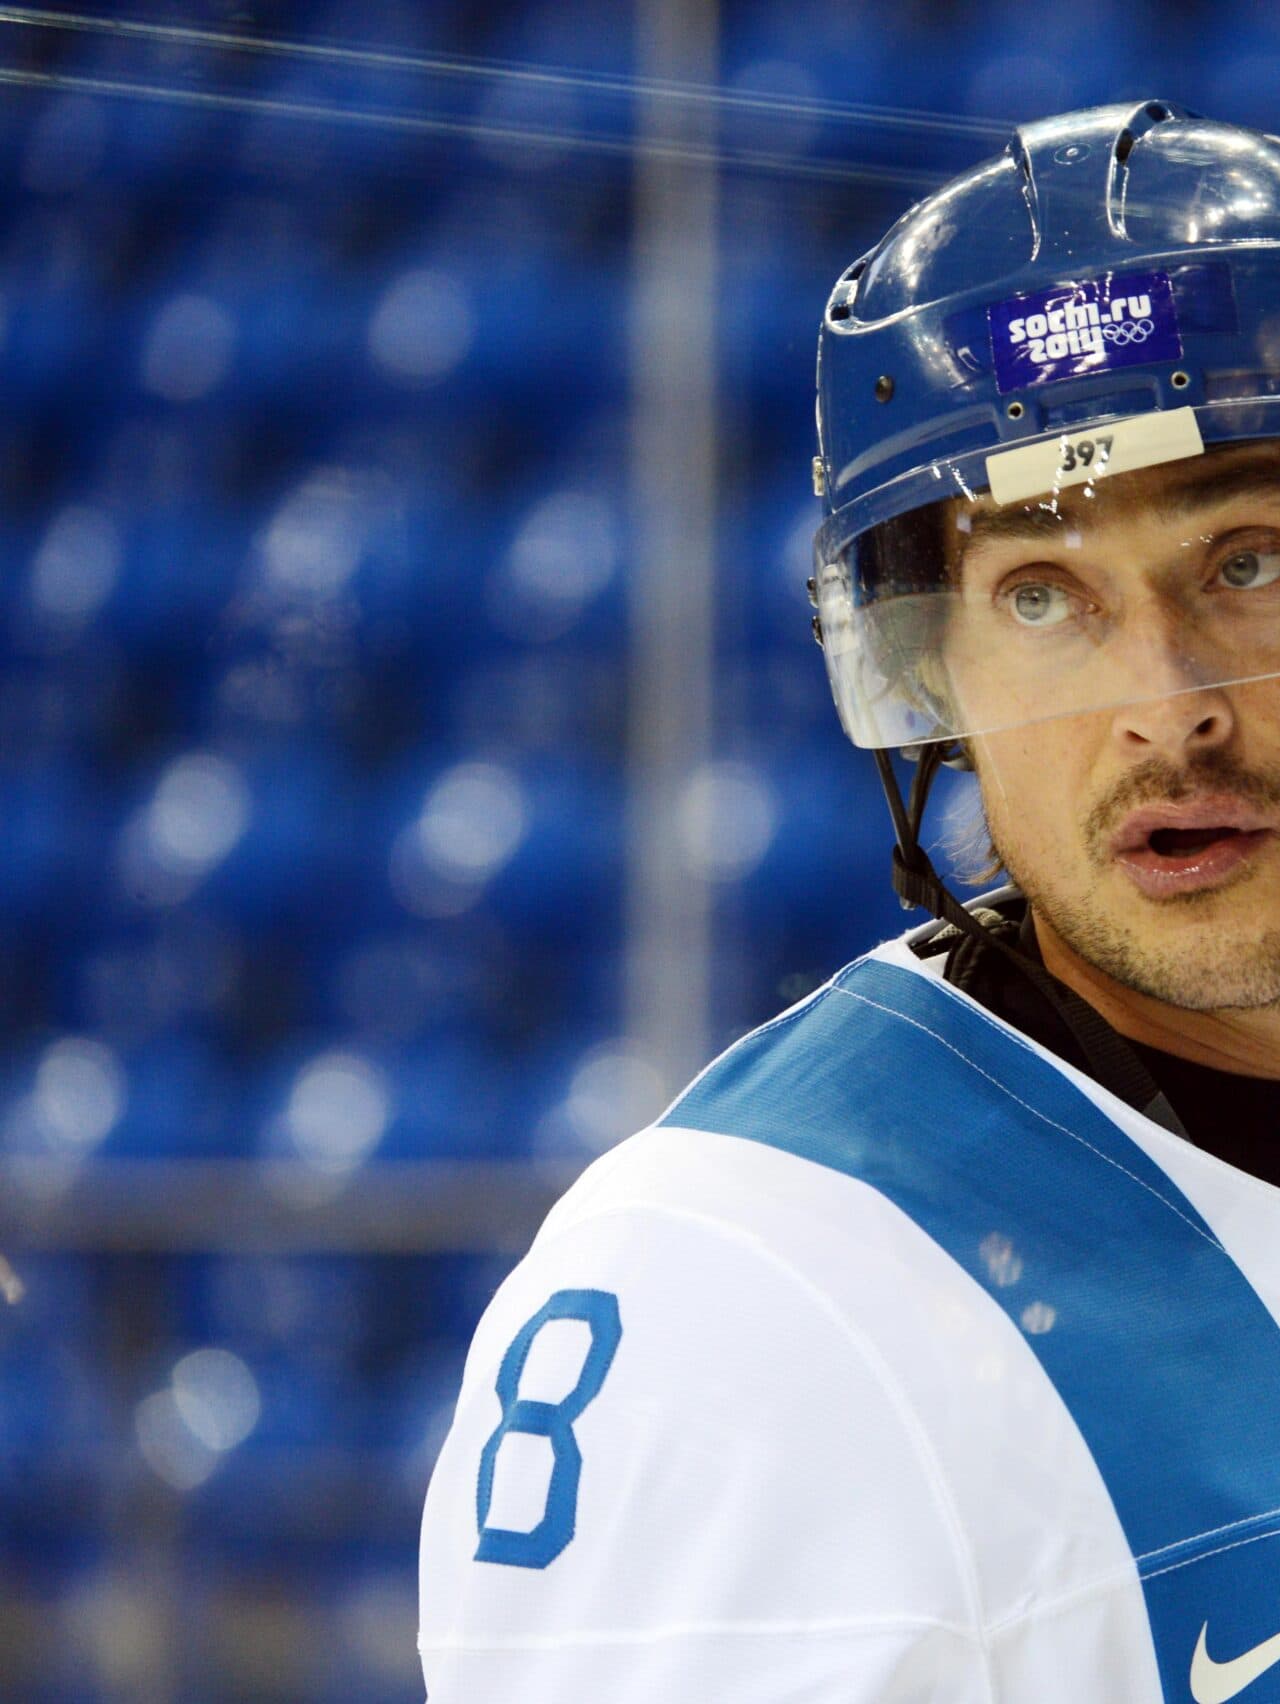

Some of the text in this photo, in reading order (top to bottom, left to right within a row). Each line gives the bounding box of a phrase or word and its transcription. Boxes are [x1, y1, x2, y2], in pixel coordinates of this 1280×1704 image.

[1028, 326, 1106, 364] 2014
[1060, 434, 1114, 472] 397
[473, 1287, 623, 1570] 8
